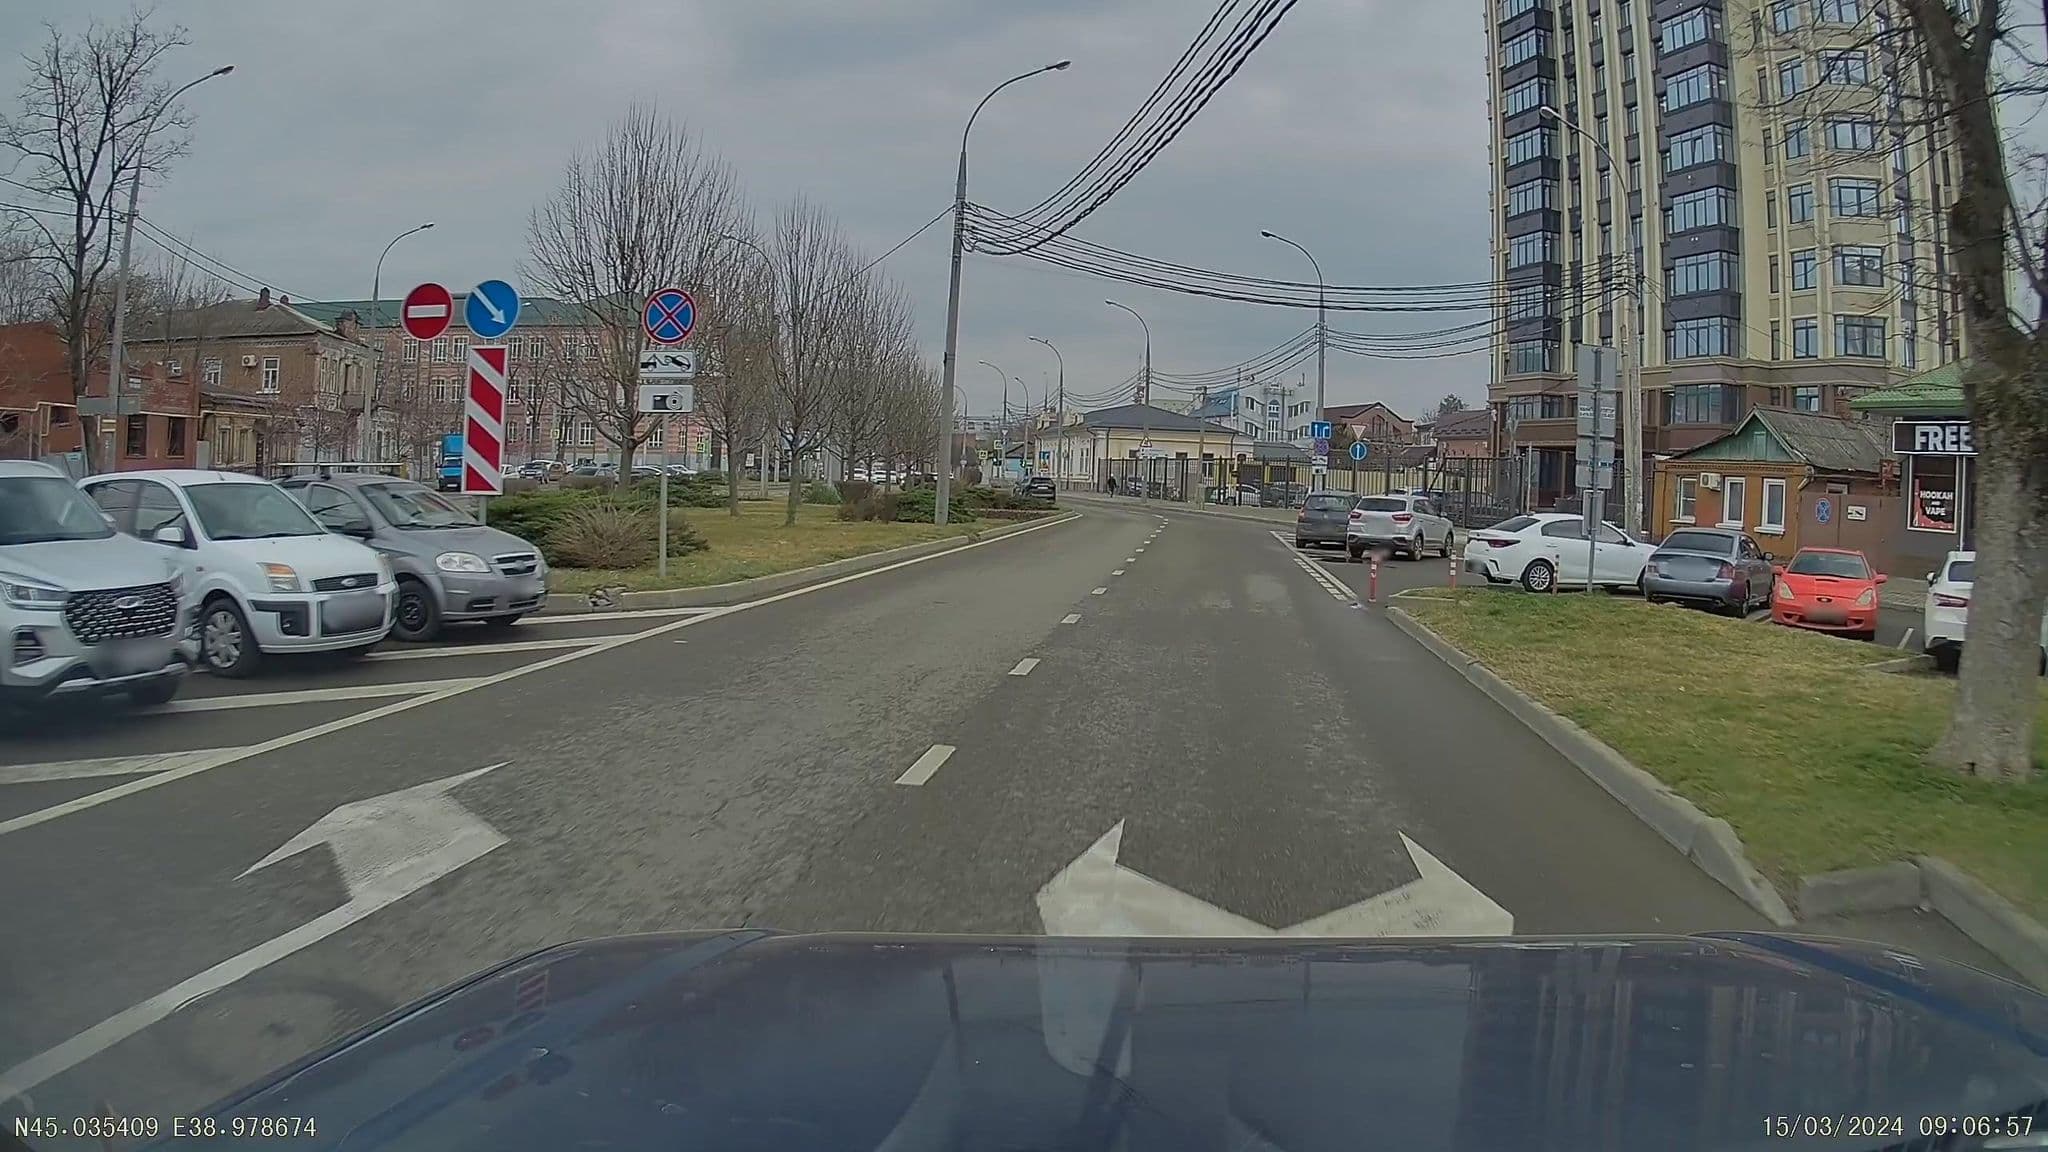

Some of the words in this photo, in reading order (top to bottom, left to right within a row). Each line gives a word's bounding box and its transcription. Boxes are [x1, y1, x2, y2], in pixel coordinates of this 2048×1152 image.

[1915, 425, 1974, 451] FREE
[1920, 490, 1953, 500] HOOKAH
[1925, 506, 1946, 516] VAPE
